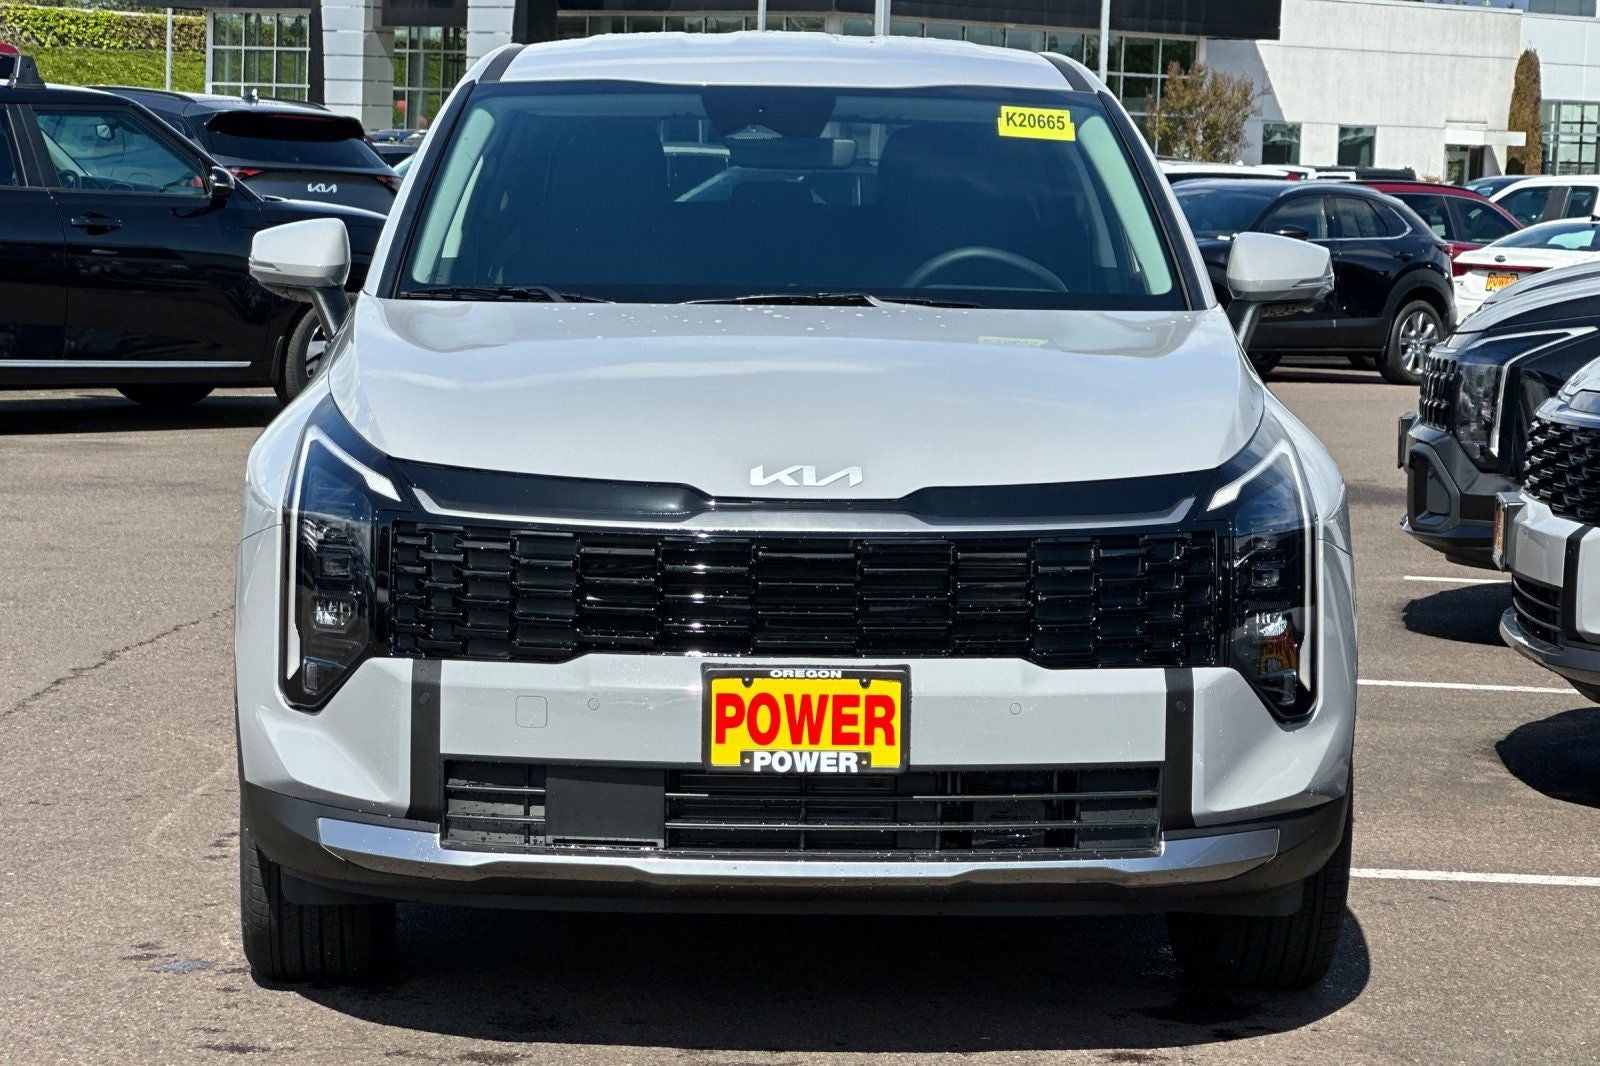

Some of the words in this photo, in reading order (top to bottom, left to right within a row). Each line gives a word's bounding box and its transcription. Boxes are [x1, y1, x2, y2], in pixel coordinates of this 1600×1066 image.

[1005, 111, 1066, 131] K20665
[307, 182, 338, 194] KIA
[750, 464, 863, 488] KIA
[769, 669, 843, 679] OREGON
[715, 692, 896, 746] POWER
[753, 751, 859, 773] POWER
